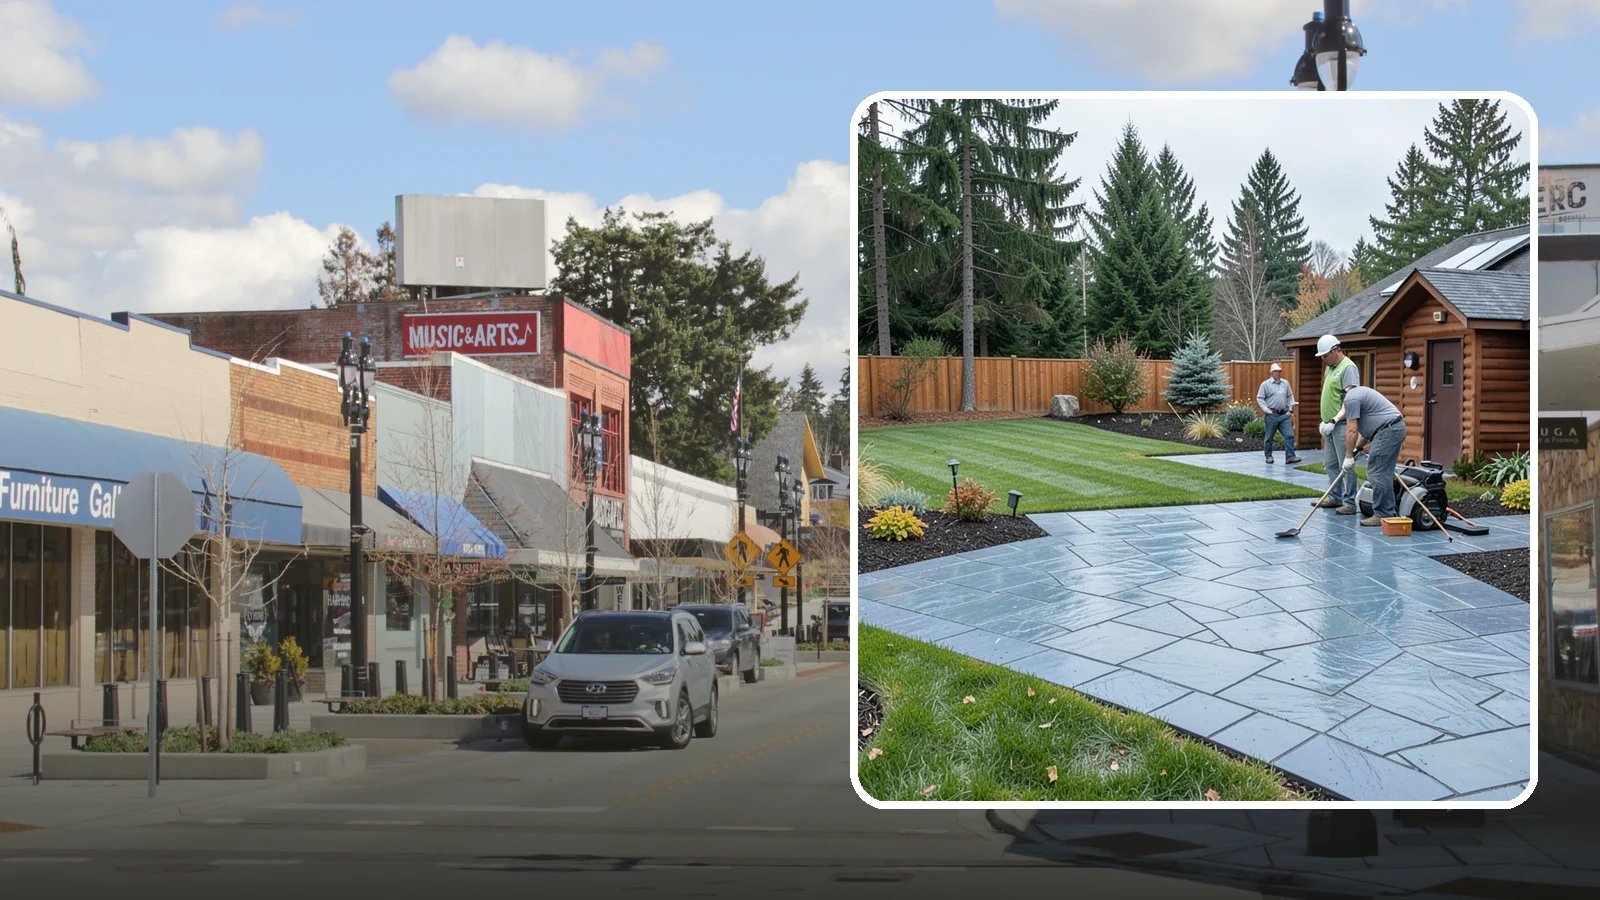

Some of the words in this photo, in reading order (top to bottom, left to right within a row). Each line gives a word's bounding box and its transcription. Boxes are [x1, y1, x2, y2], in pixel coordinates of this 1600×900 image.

[408, 322, 521, 349] MUSIC&ARTS
[1540, 427, 1577, 437] UGA
[0, 472, 79, 515] Furniture
[90, 482, 122, 519] Gal
[453, 563, 479, 574] SUSHI
